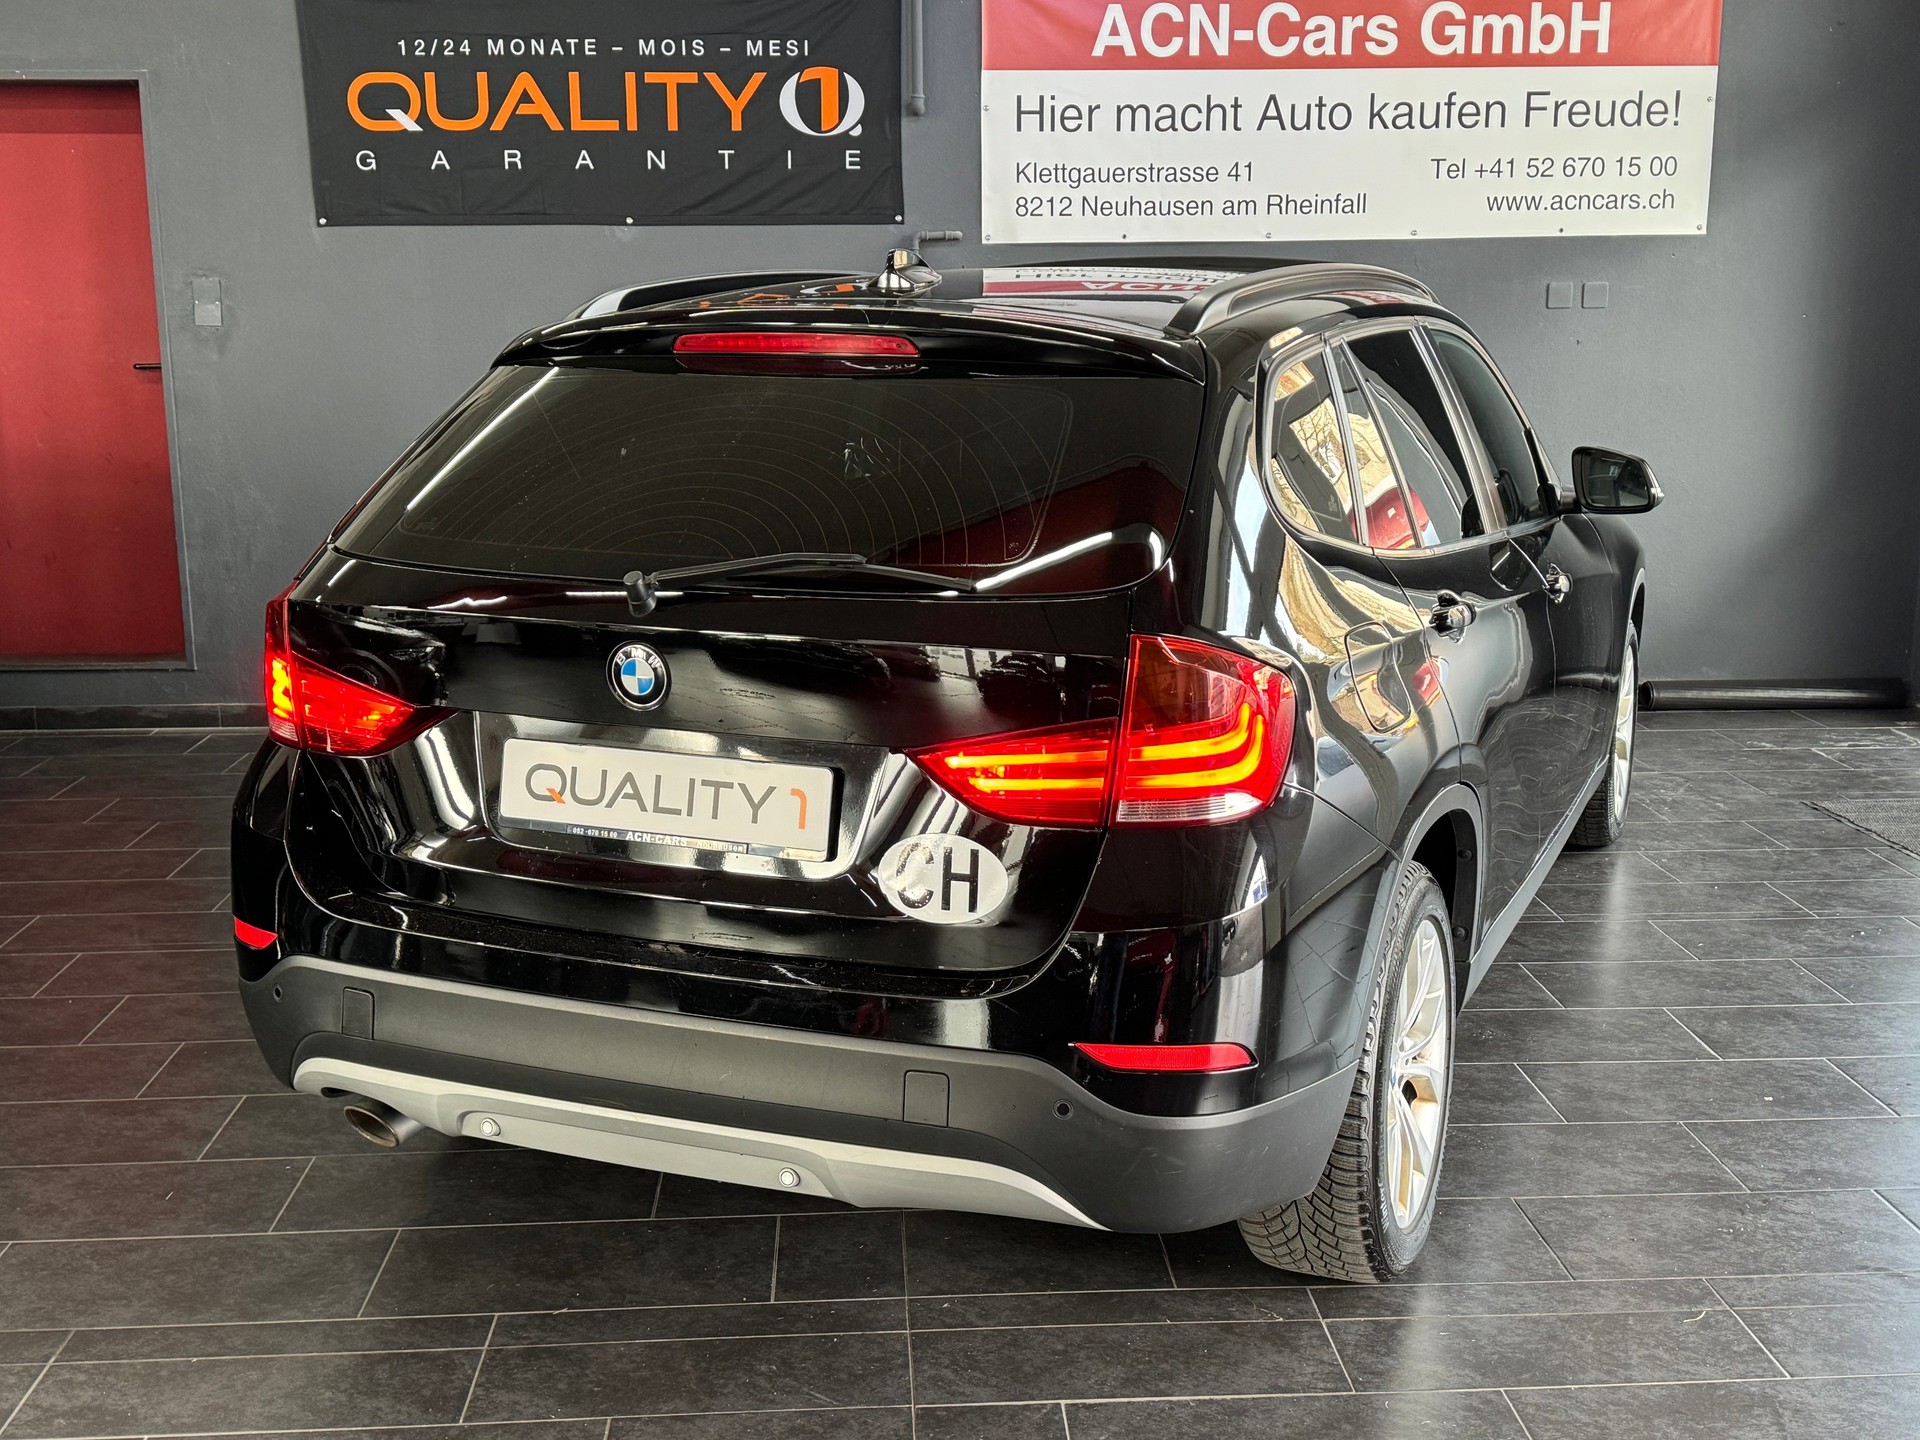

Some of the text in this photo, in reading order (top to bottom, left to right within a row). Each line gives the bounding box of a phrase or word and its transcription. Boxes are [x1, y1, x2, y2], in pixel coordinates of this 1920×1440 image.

[1090, 0, 1613, 58] ACN-Cars GmbH
[397, 38, 471, 57] 12/24
[487, 38, 598, 57] MONATE
[638, 38, 705, 57] MOIS
[746, 39, 809, 58] MESI
[346, 71, 768, 132] QUALITY
[1016, 90, 1682, 133] Hier macht Auto kaufen Freude!
[355, 148, 862, 171] GARANTIE
[1430, 155, 1678, 180] Tel +41 52 670 15 00
[1015, 161, 1255, 189] Klettgauerstrasse 41
[1015, 192, 1367, 218] 8212 Neuhausen am Rheinfall
[1486, 188, 1675, 212] www.acncars.ch
[615, 646, 661, 669] BMW
[524, 762, 777, 825] QUALITY
[625, 830, 689, 847] ACN-CARS
[895, 842, 980, 913] CH
